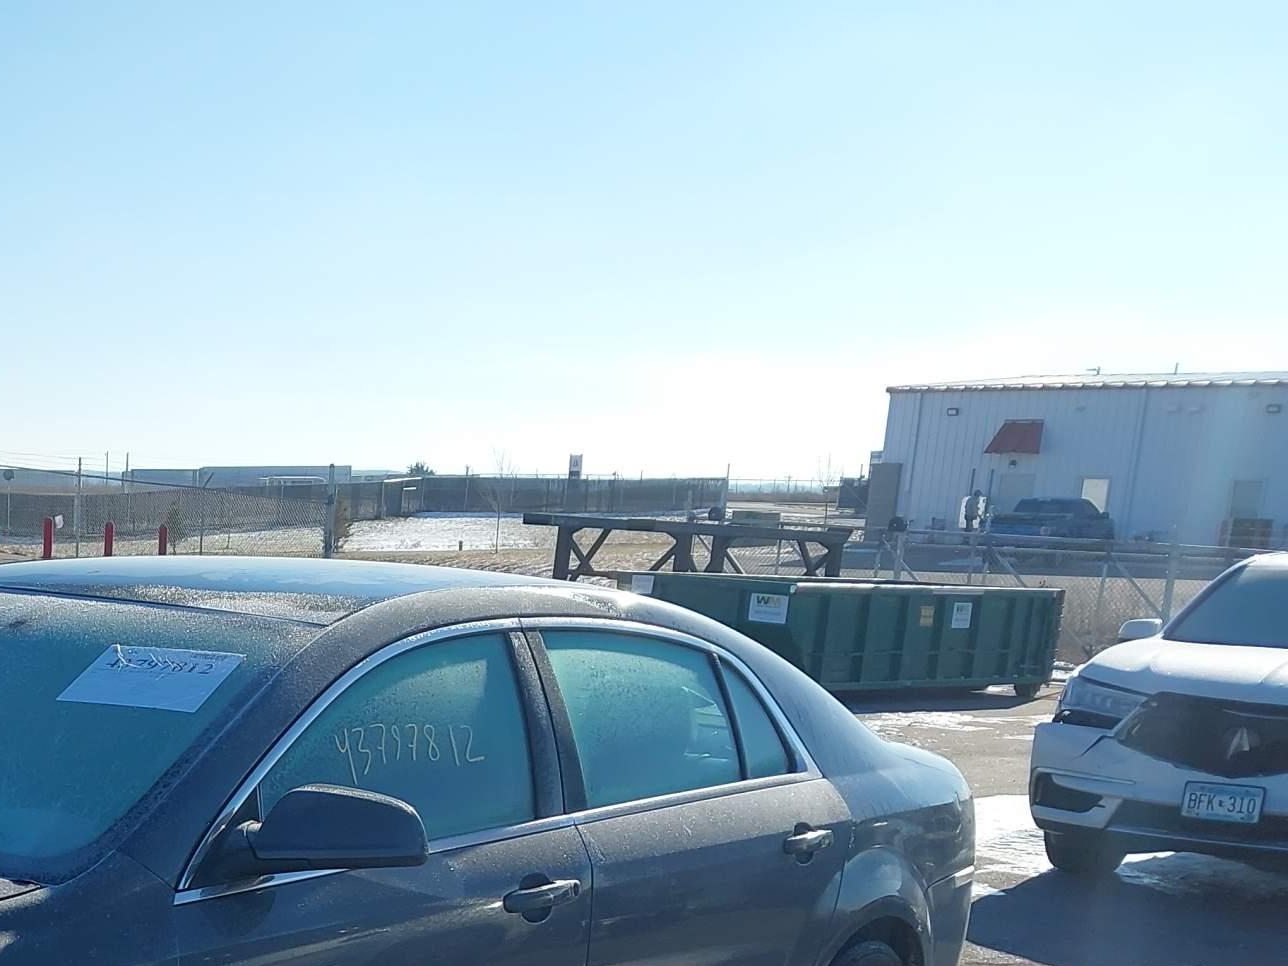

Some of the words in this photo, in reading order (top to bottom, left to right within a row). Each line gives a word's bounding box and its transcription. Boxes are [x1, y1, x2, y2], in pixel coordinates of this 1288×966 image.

[334, 723, 485, 785] 43797812
[1187, 792, 1217, 811] BFK
[1226, 795, 1257, 814] 310
